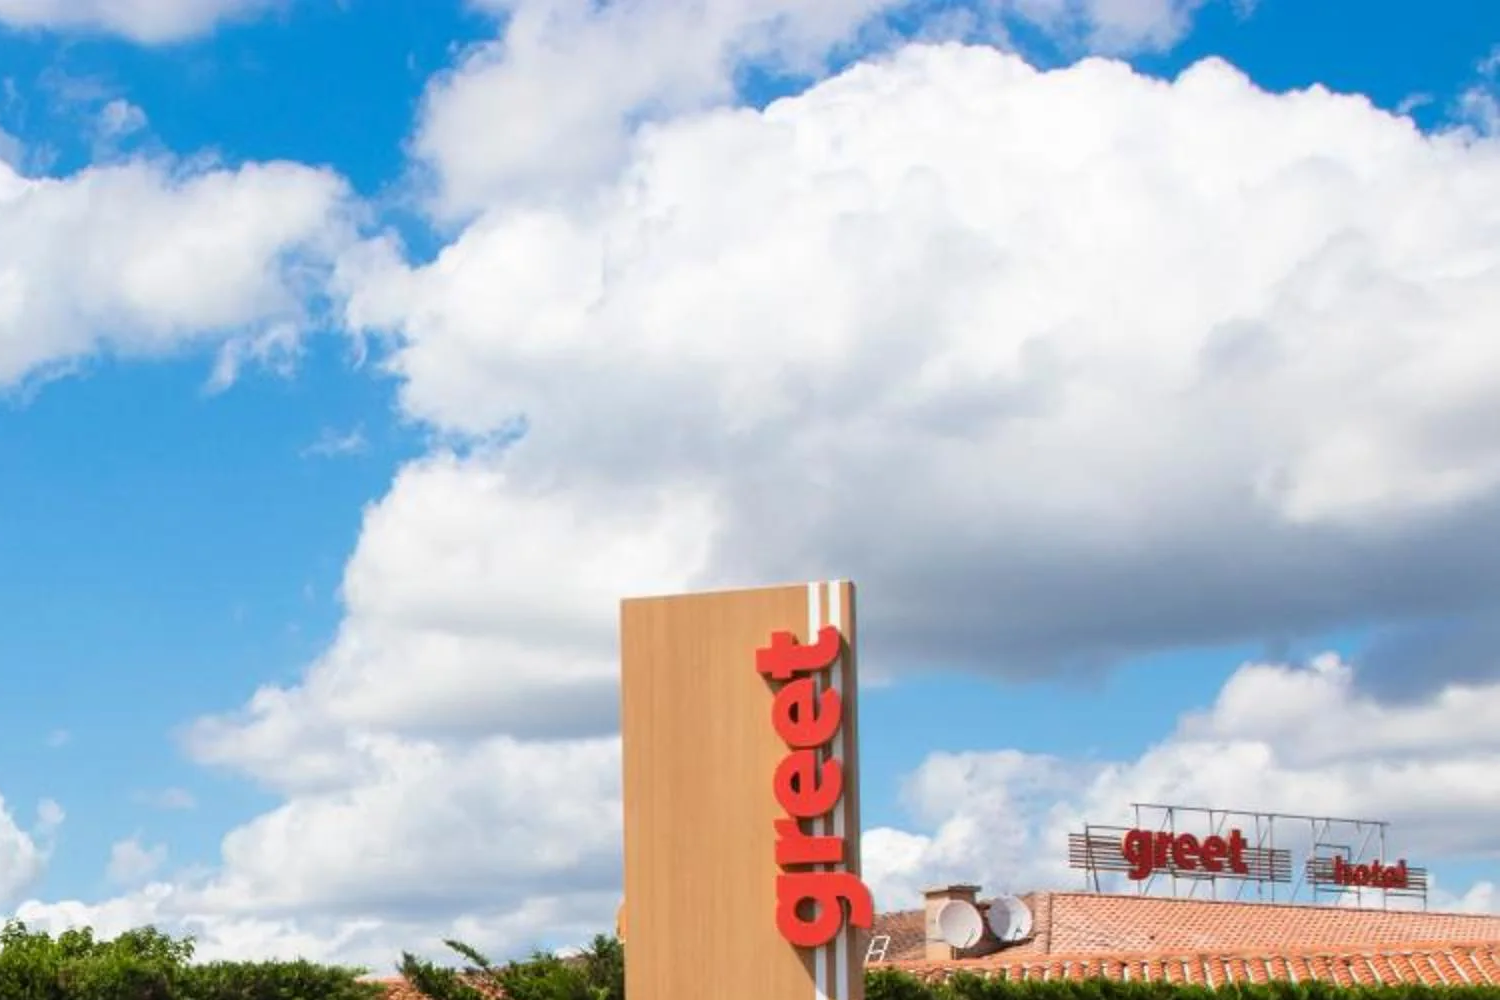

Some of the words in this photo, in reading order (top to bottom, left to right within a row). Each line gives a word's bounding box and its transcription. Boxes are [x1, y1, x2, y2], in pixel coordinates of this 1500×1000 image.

[756, 625, 873, 948] greet
[1123, 828, 1248, 880] greet
[1334, 855, 1407, 888] hotel
